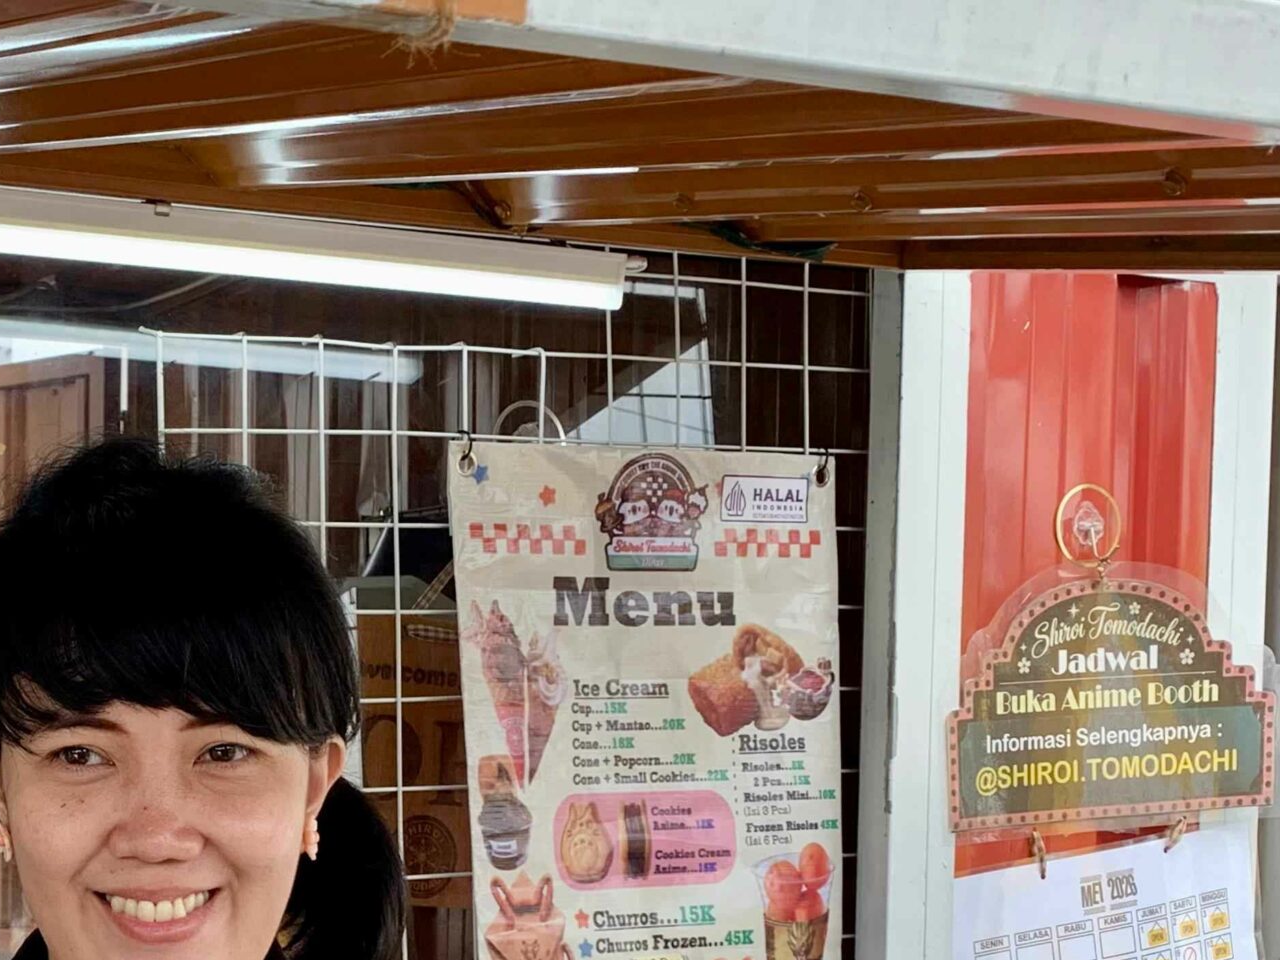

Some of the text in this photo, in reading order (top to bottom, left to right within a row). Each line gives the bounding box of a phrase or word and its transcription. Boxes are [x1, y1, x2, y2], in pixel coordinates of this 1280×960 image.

[753, 488, 804, 503] HALAL
[752, 504, 804, 512] INDONESIA
[553, 576, 736, 627] Menu
[1031, 602, 1184, 659] Shiroi Tomodachi
[1051, 644, 1158, 675] Jadwal
[573, 679, 669, 697] Ice Cream
[996, 681, 1219, 715] Buka Anime Booth
[572, 720, 592, 734] Cup
[738, 733, 806, 752] Risoles
[986, 721, 1211, 754] Informasi Selengkapnya
[572, 756, 600, 768] Cone
[573, 773, 601, 785] Cone
[614, 772, 647, 784] Small
[975, 749, 1238, 796] @SHIROI.TOMODACHI
[743, 791, 784, 803] Risoles
[651, 805, 692, 816] Cookies
[746, 822, 784, 833] Frozen
[786, 820, 819, 831] Risoles
[655, 847, 732, 860] Cookies Cream
[1081, 873, 1138, 908] MEI 2026
[593, 904, 717, 929] Churros...15K
[980, 938, 1004, 950] SENIN
[1017, 929, 1050, 943] SELASA
[1064, 922, 1087, 934] RABU
[1103, 914, 1128, 926] KAMIS
[1141, 906, 1163, 918] JUMAT
[595, 929, 755, 954] Churros Frozen...45K
